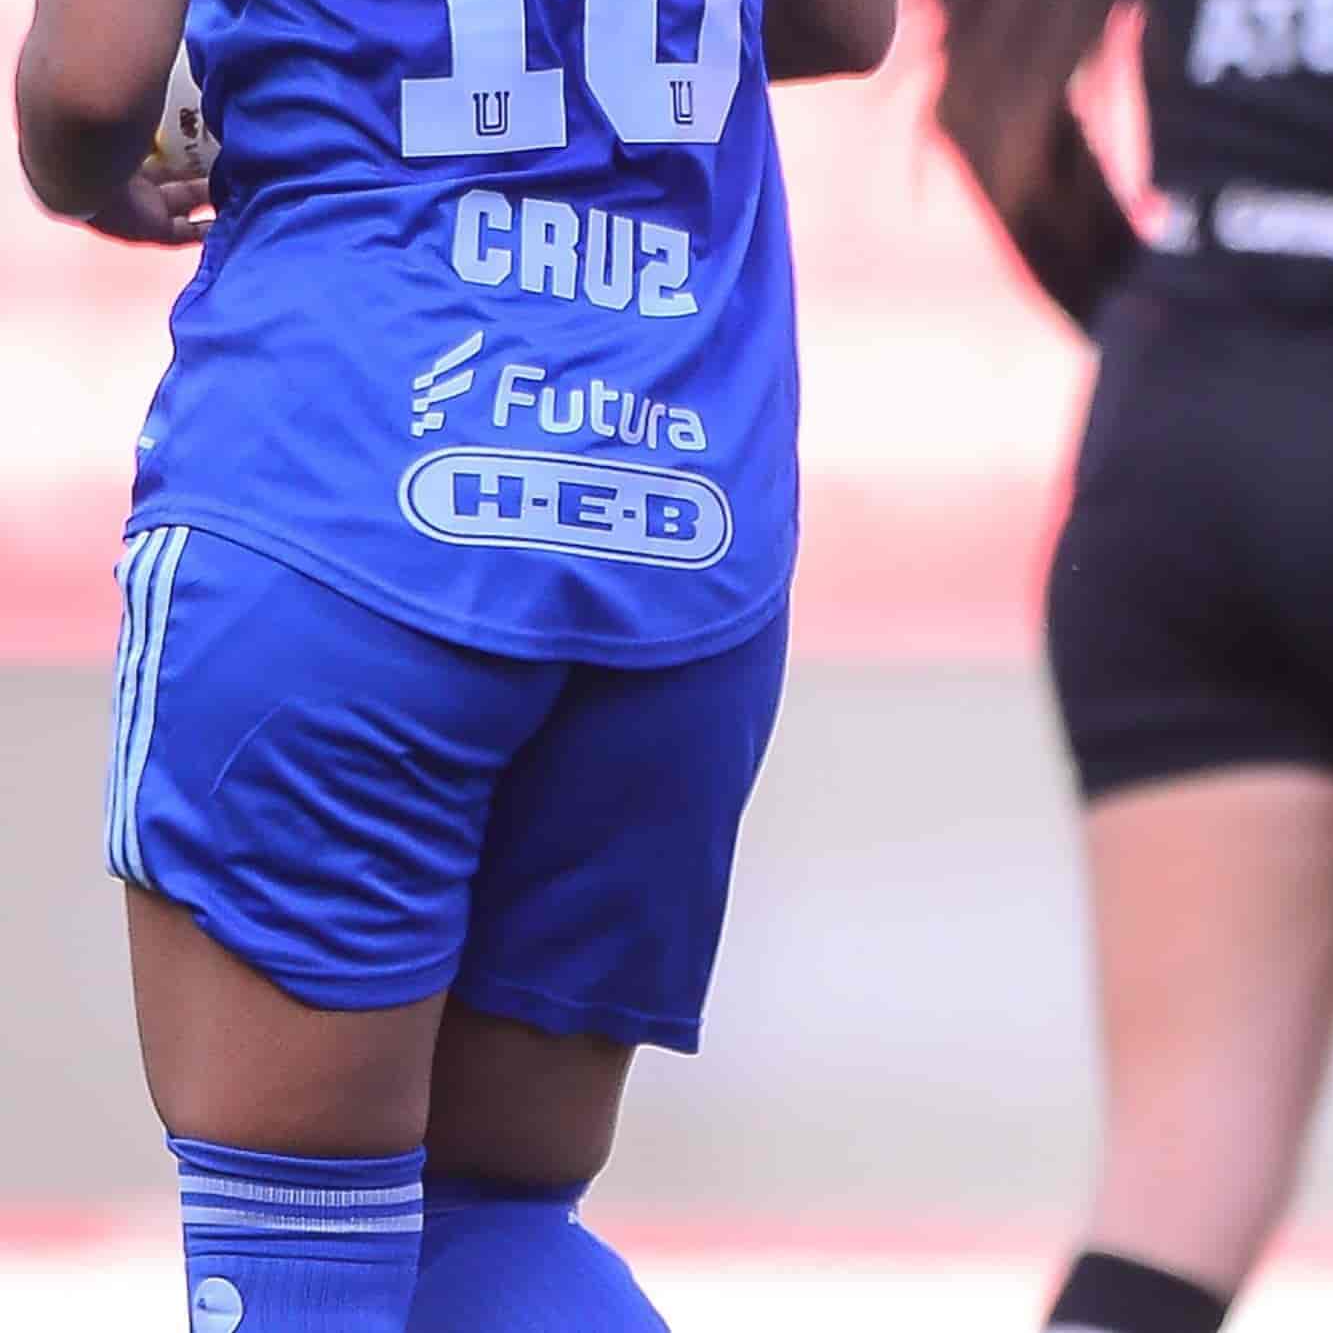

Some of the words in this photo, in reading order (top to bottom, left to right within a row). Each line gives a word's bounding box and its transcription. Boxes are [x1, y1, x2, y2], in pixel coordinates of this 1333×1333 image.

[452, 188, 699, 318] CRUZ
[493, 364, 707, 451] Futura
[452, 471, 700, 542] H-E-B
